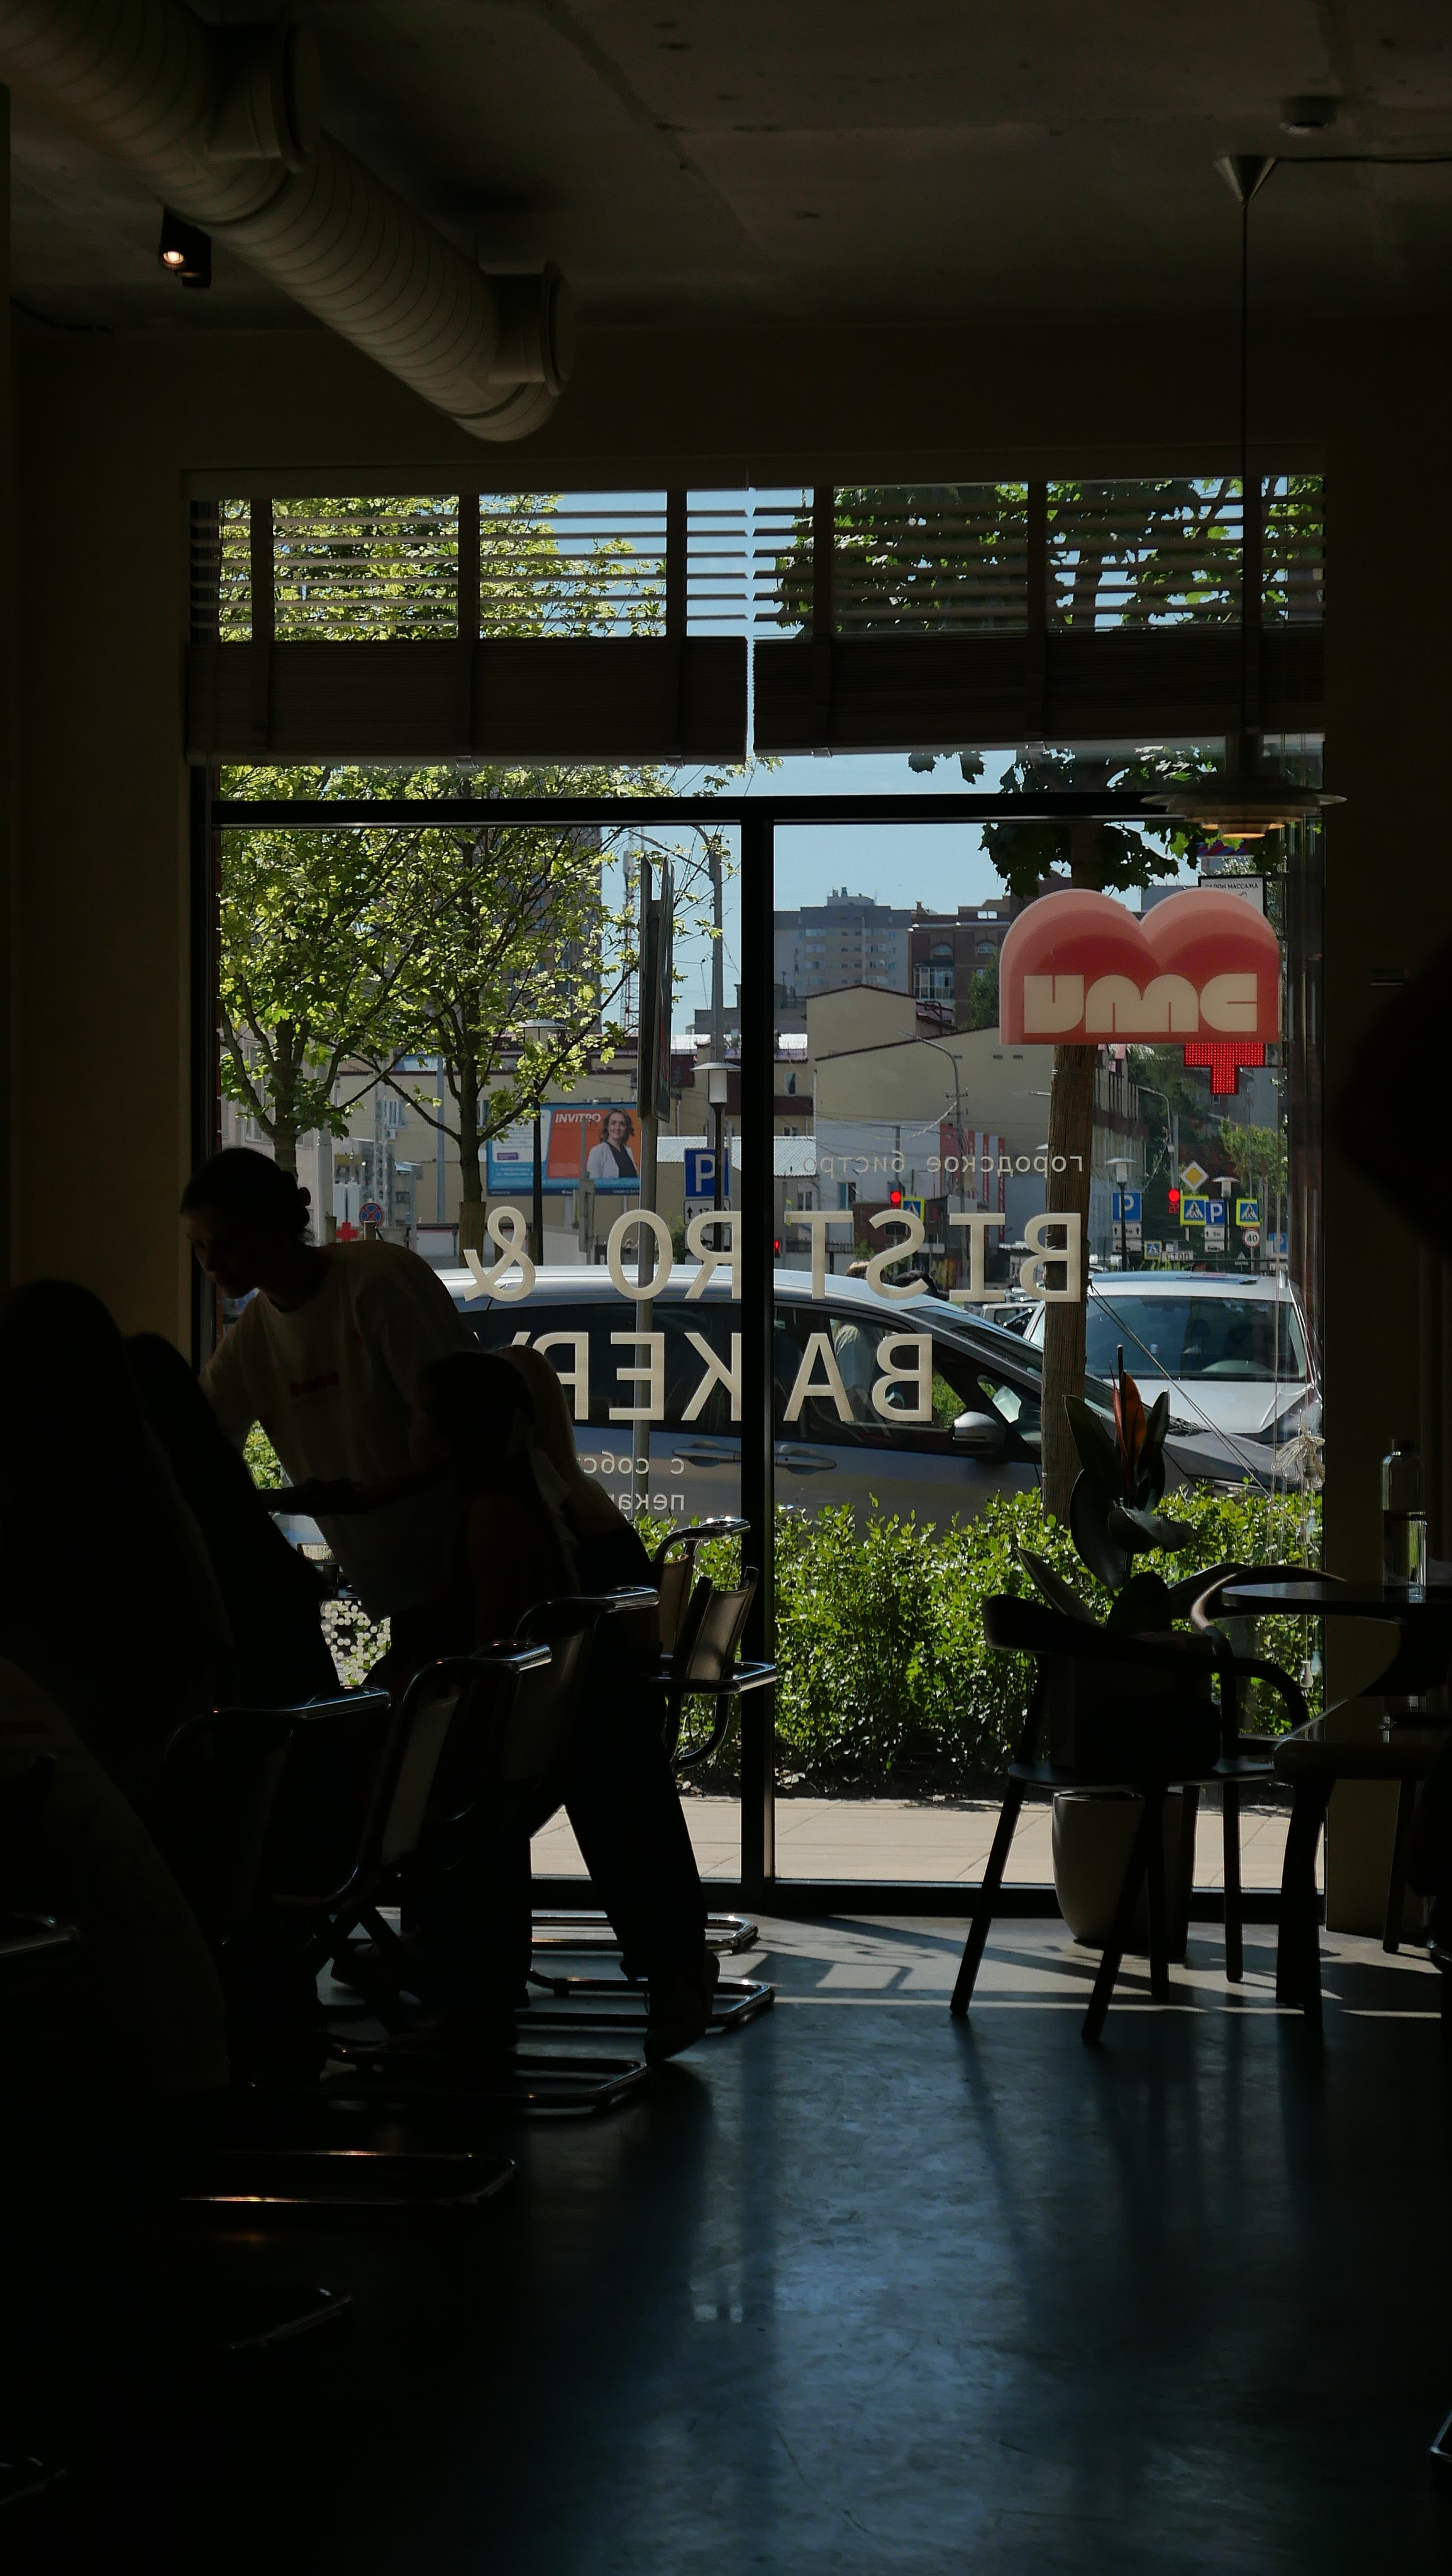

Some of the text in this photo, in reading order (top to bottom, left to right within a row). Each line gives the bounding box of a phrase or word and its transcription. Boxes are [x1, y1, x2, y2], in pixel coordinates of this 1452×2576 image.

[555, 1113, 601, 1123] INVITRO
[696, 1154, 716, 1192] P
[1119, 1195, 1134, 1219] P
[1211, 1204, 1223, 1223] P
[1167, 1252, 1189, 1261] СТОП
